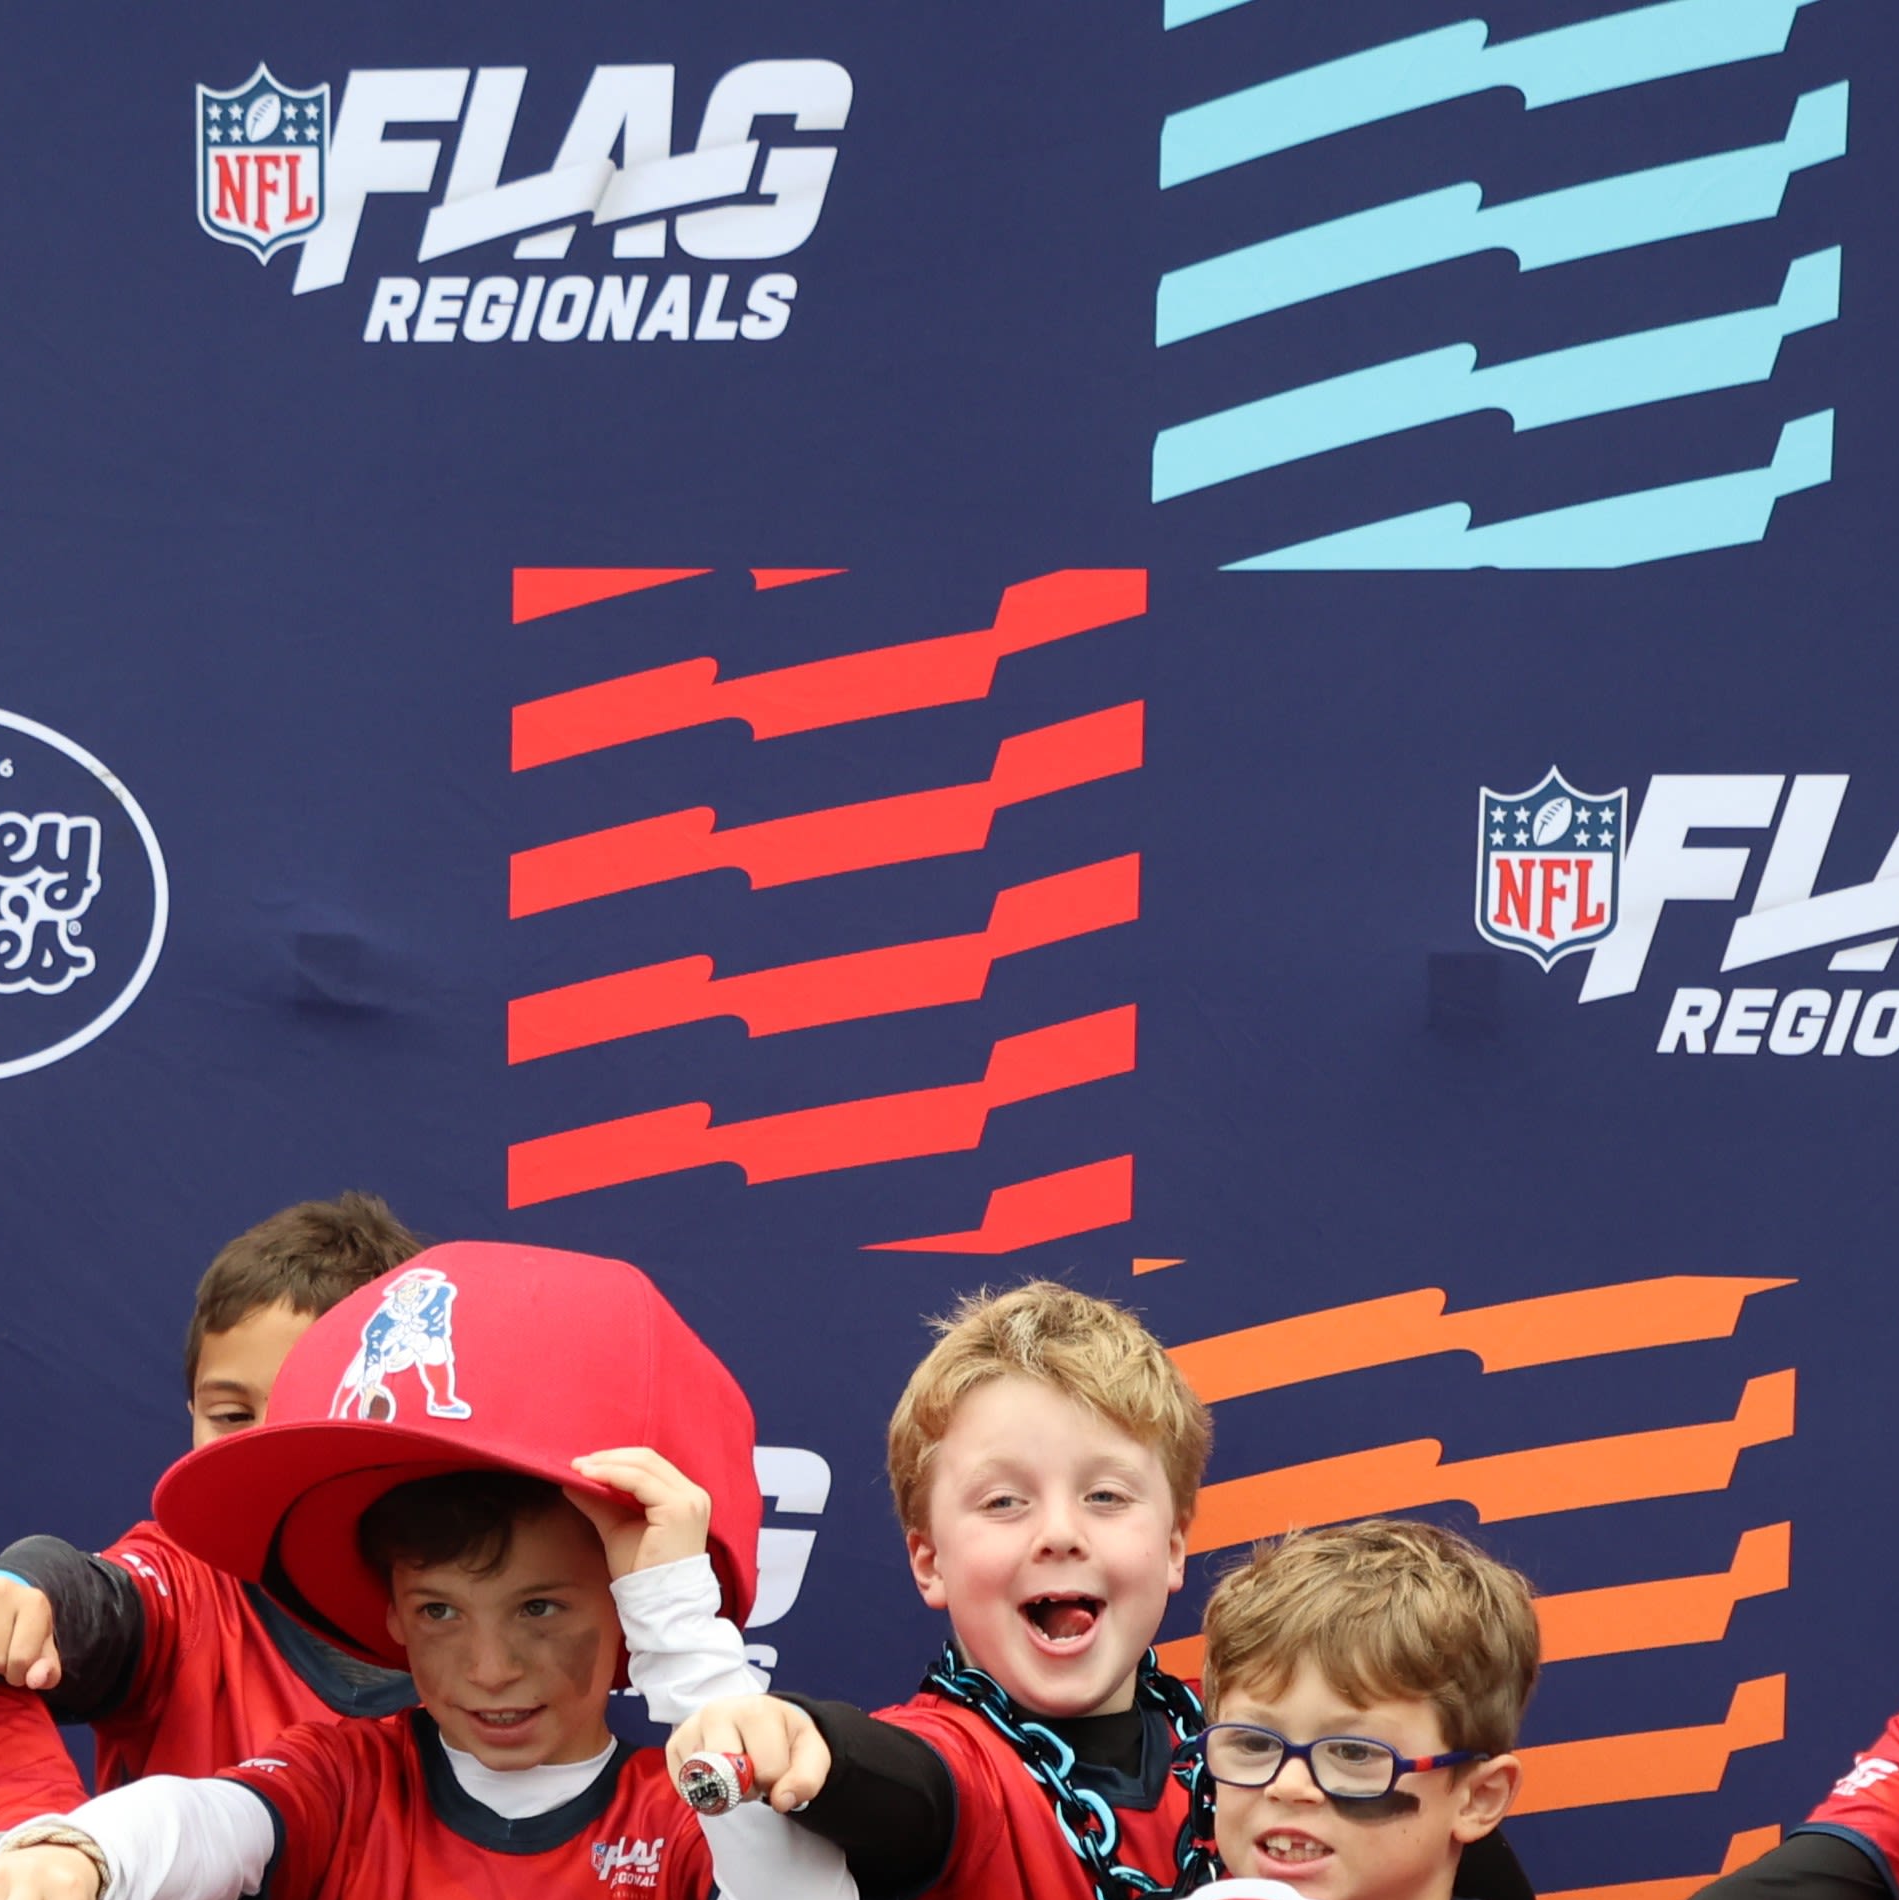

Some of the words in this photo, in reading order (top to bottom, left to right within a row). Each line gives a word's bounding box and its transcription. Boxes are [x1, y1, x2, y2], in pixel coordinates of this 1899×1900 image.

[213, 153, 314, 236] NFL
[292, 58, 855, 296] FLAG
[363, 273, 799, 344] REGIONALS
[1494, 857, 1606, 942] NFL
